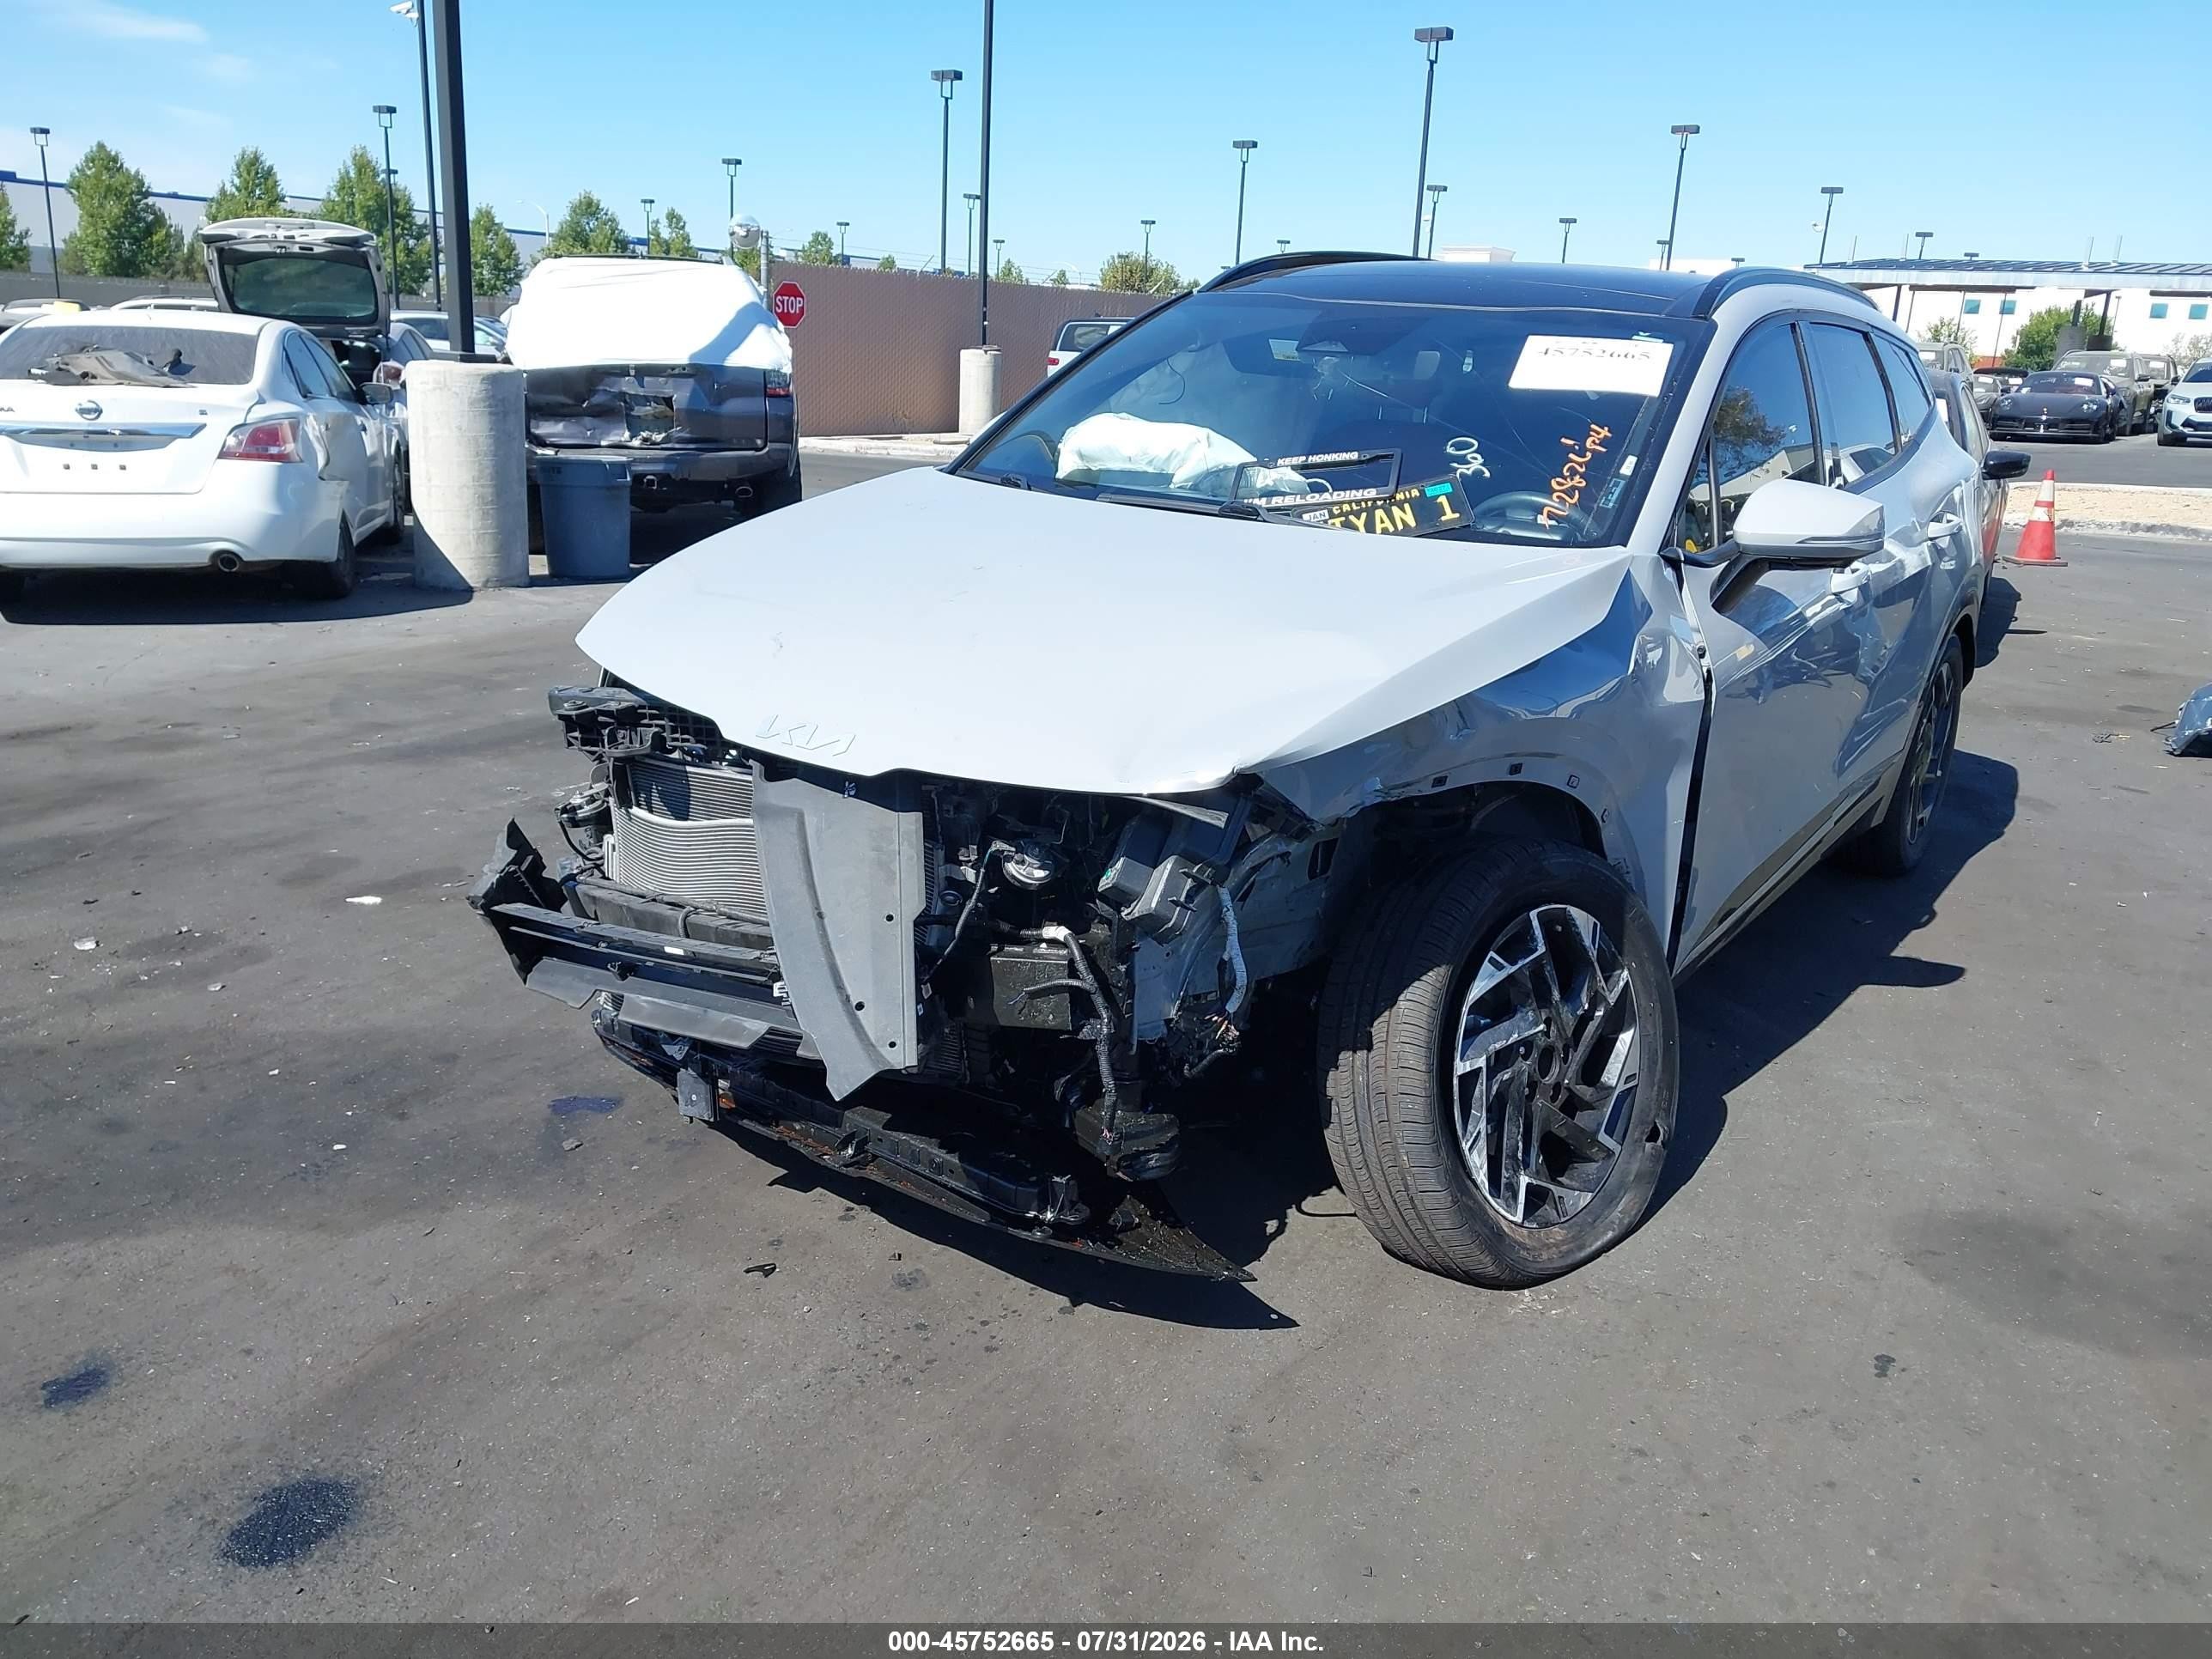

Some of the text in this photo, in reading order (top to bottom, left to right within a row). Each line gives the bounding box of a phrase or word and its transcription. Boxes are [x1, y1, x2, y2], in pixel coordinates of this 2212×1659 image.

[775, 295, 804, 313] STOP
[1277, 452, 1359, 466] KEEP HONKING
[1446, 436, 1491, 479] 360
[1271, 488, 1377, 505] RELOADING
[1309, 511, 1327, 521] JAN
[1436, 495, 1460, 521] 1
